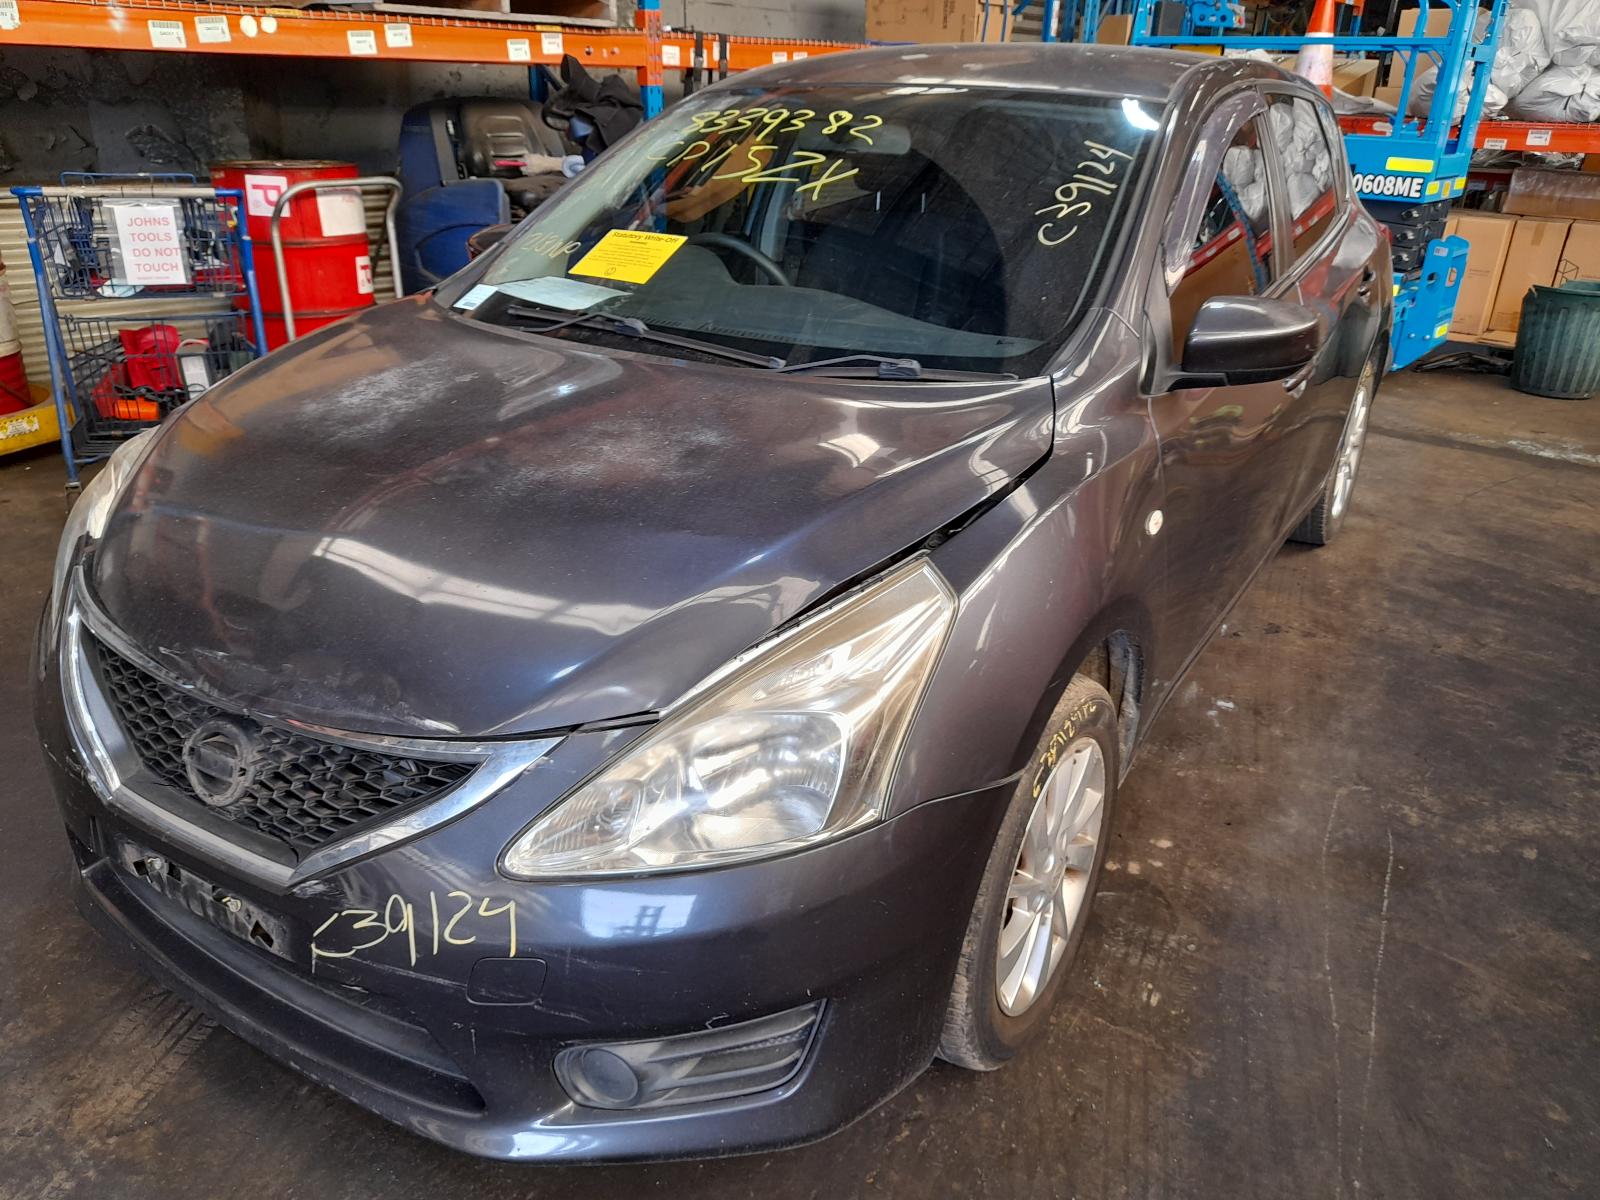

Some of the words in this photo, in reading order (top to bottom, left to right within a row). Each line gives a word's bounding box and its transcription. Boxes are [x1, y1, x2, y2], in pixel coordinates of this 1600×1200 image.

[1034, 140, 1134, 246] C39124
[127, 216, 170, 227] JOHNS
[129, 232, 172, 242] TOOLS
[132, 248, 151, 258] DO
[154, 247, 180, 257] NOT
[135, 262, 179, 273] TOUCH
[311, 890, 517, 968] C39124
